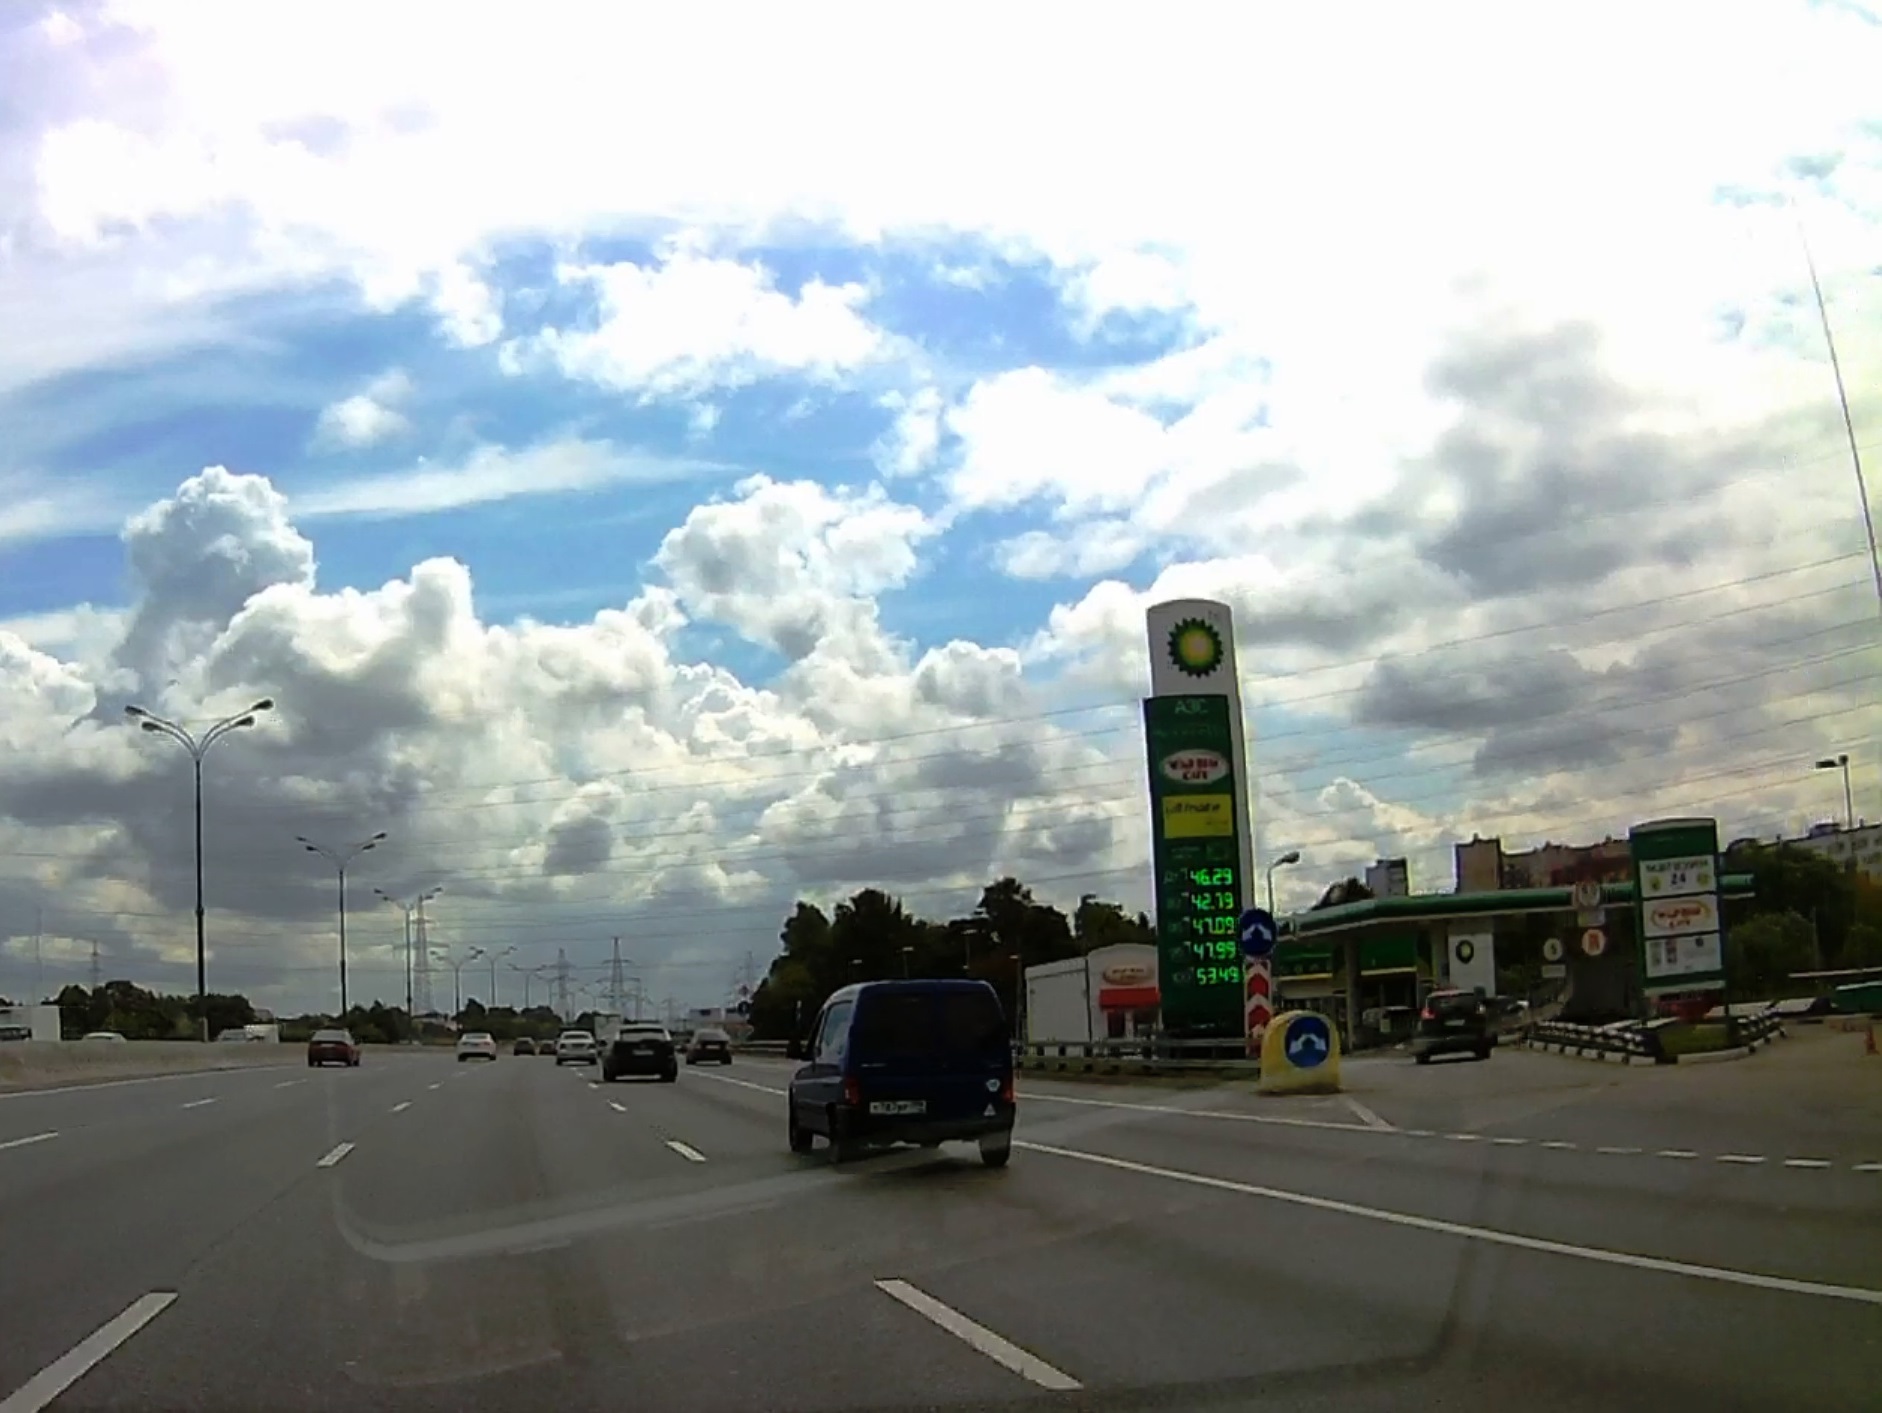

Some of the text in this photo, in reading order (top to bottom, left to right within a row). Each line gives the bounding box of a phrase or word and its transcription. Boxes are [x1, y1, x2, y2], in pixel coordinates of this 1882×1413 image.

[1189, 867, 1233, 886] 46.29
[1191, 891, 1235, 911] 42.79
[1192, 916, 1236, 936] 47.09
[1193, 941, 1237, 960] 47.99
[1196, 966, 1240, 985] 53.49
